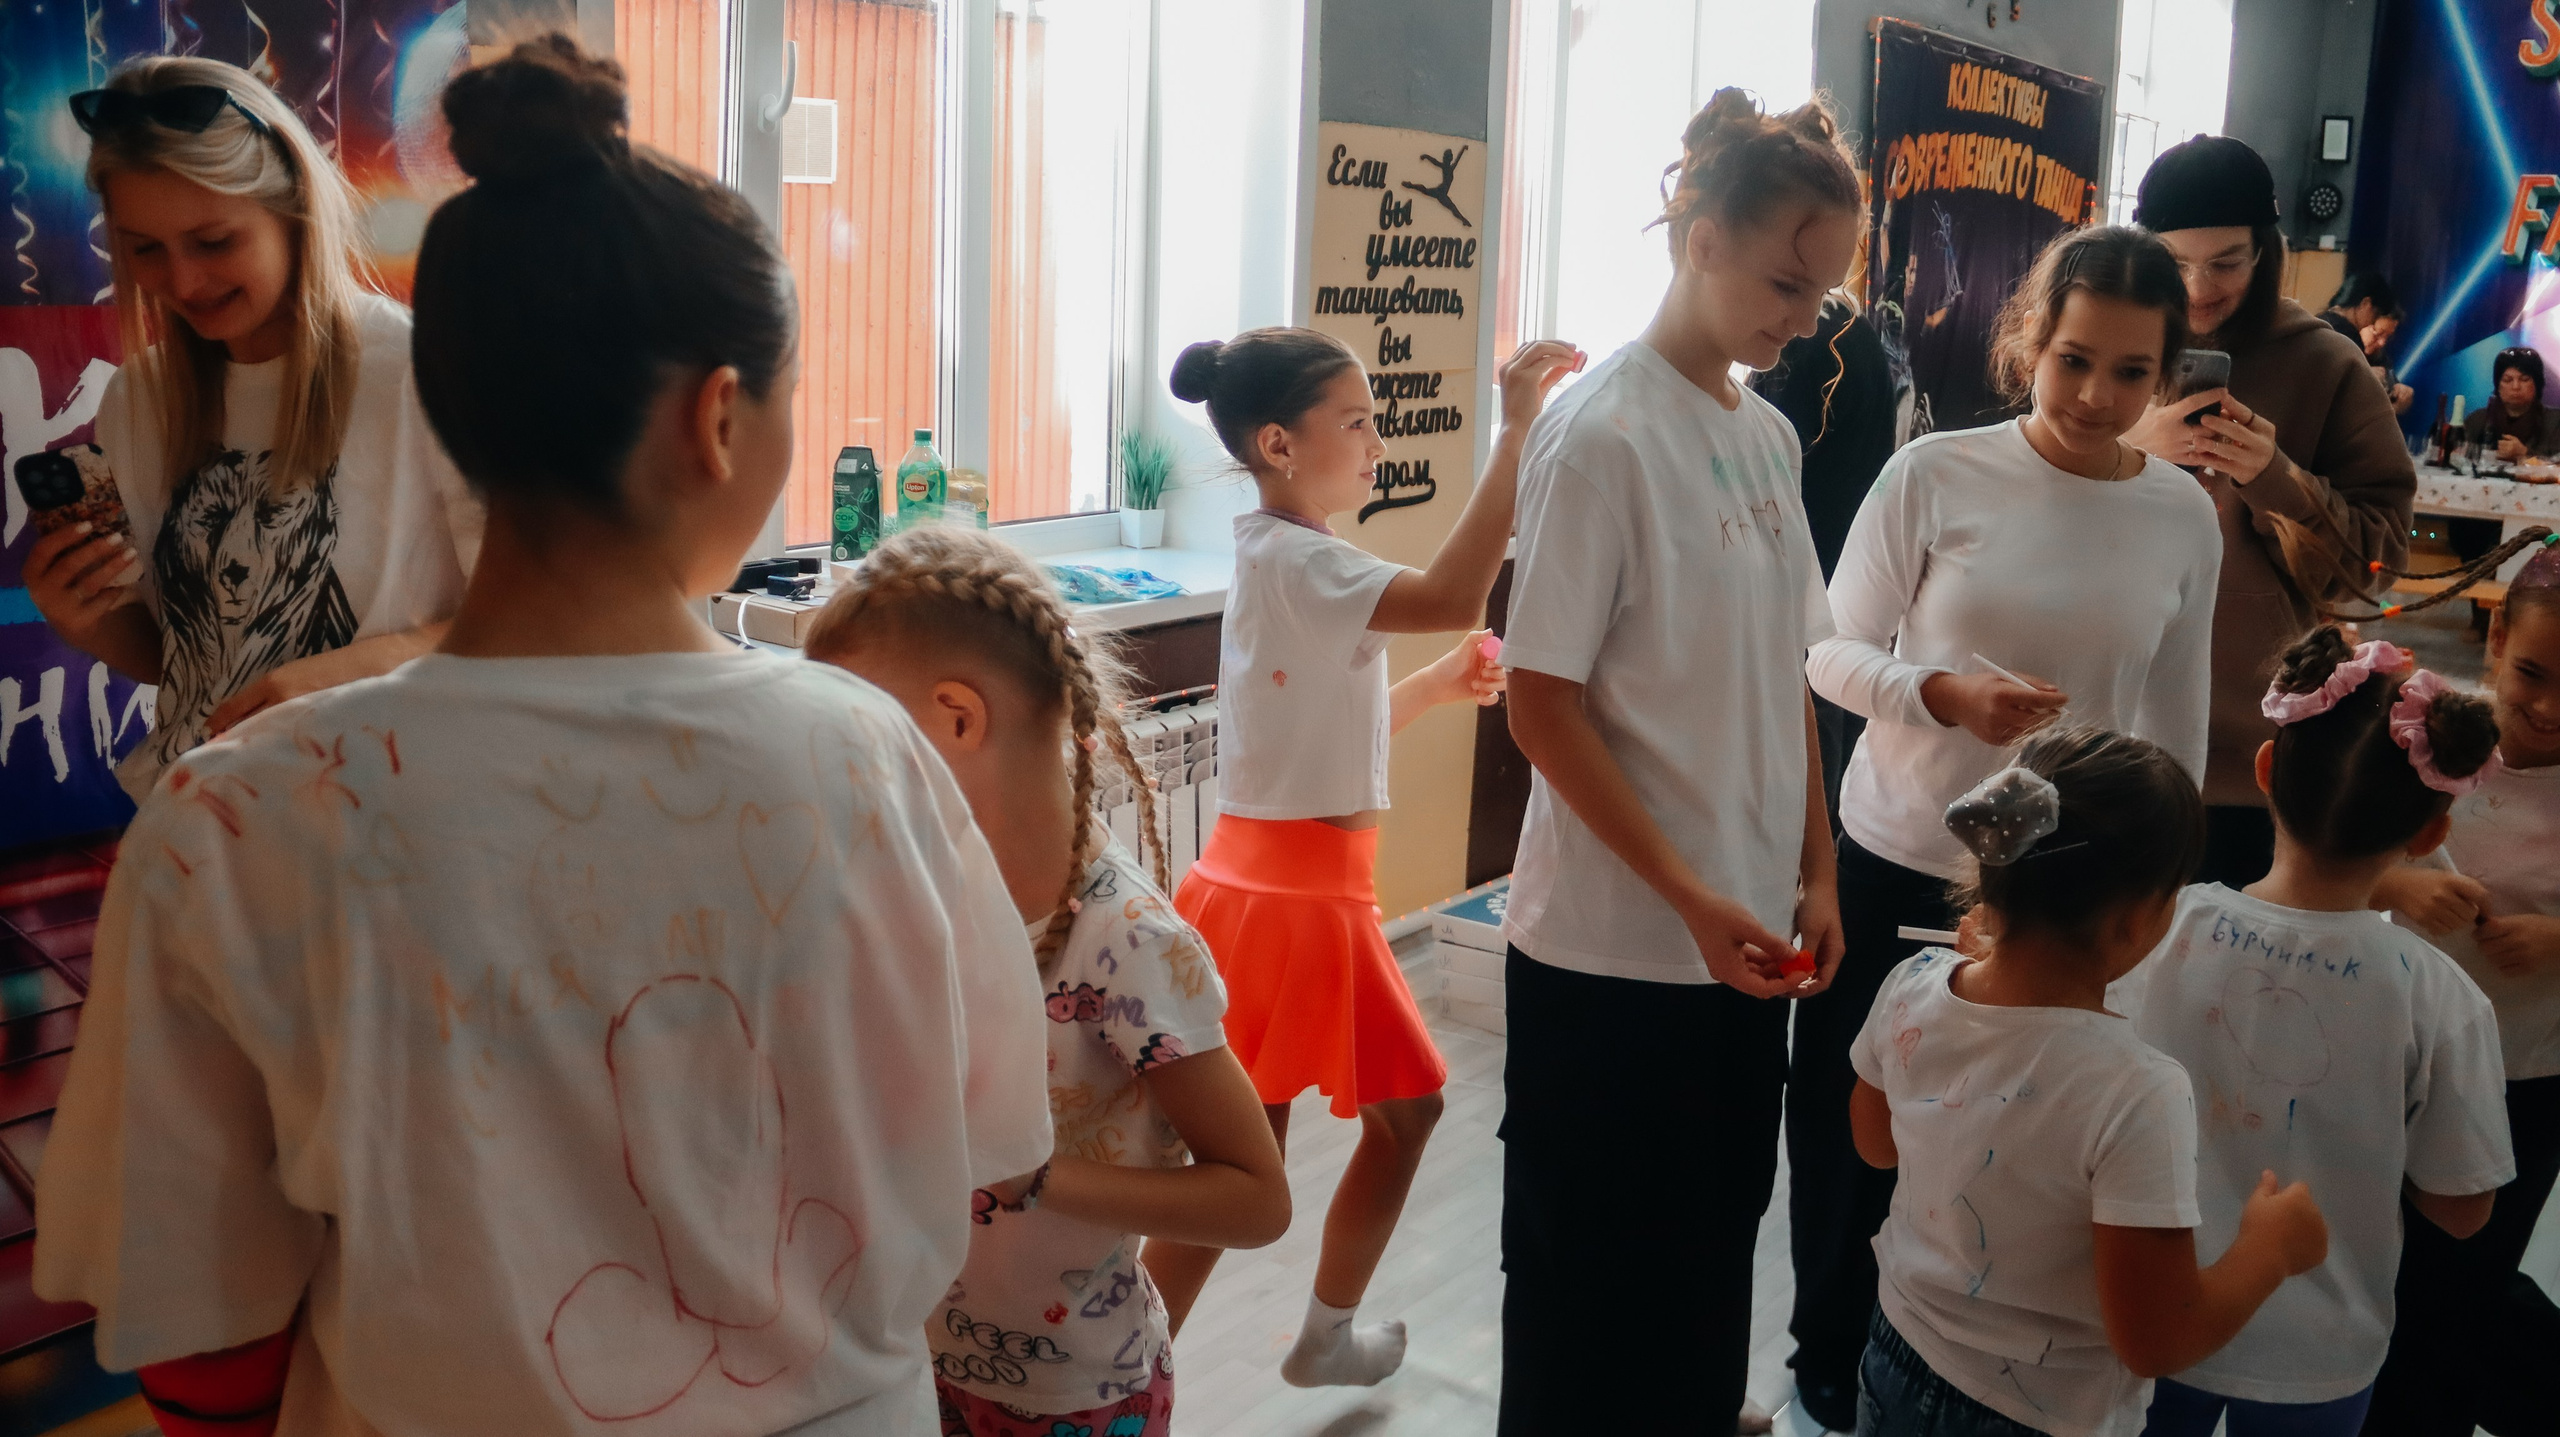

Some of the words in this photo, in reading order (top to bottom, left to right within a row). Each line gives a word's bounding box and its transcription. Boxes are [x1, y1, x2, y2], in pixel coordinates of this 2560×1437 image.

[2518, 0, 2560, 72] S
[1947, 61, 2048, 129] КОЛЛЕКТИВЫ
[1327, 143, 1388, 189] Если
[1884, 130, 2033, 200] СОВРЕМЕННОГО
[2033, 154, 2086, 224] ТАНЦА
[1379, 189, 1413, 230] вы
[1365, 233, 1477, 281] умеете
[1315, 274, 1464, 326] танцевать,
[1378, 326, 1412, 366] вы
[1367, 372, 1442, 400] ожете
[1373, 399, 1462, 439] авлять
[906, 483, 925, 492] Lipton
[0, 660, 158, 783] НИ
[946, 1308, 1071, 1363] FEEL
